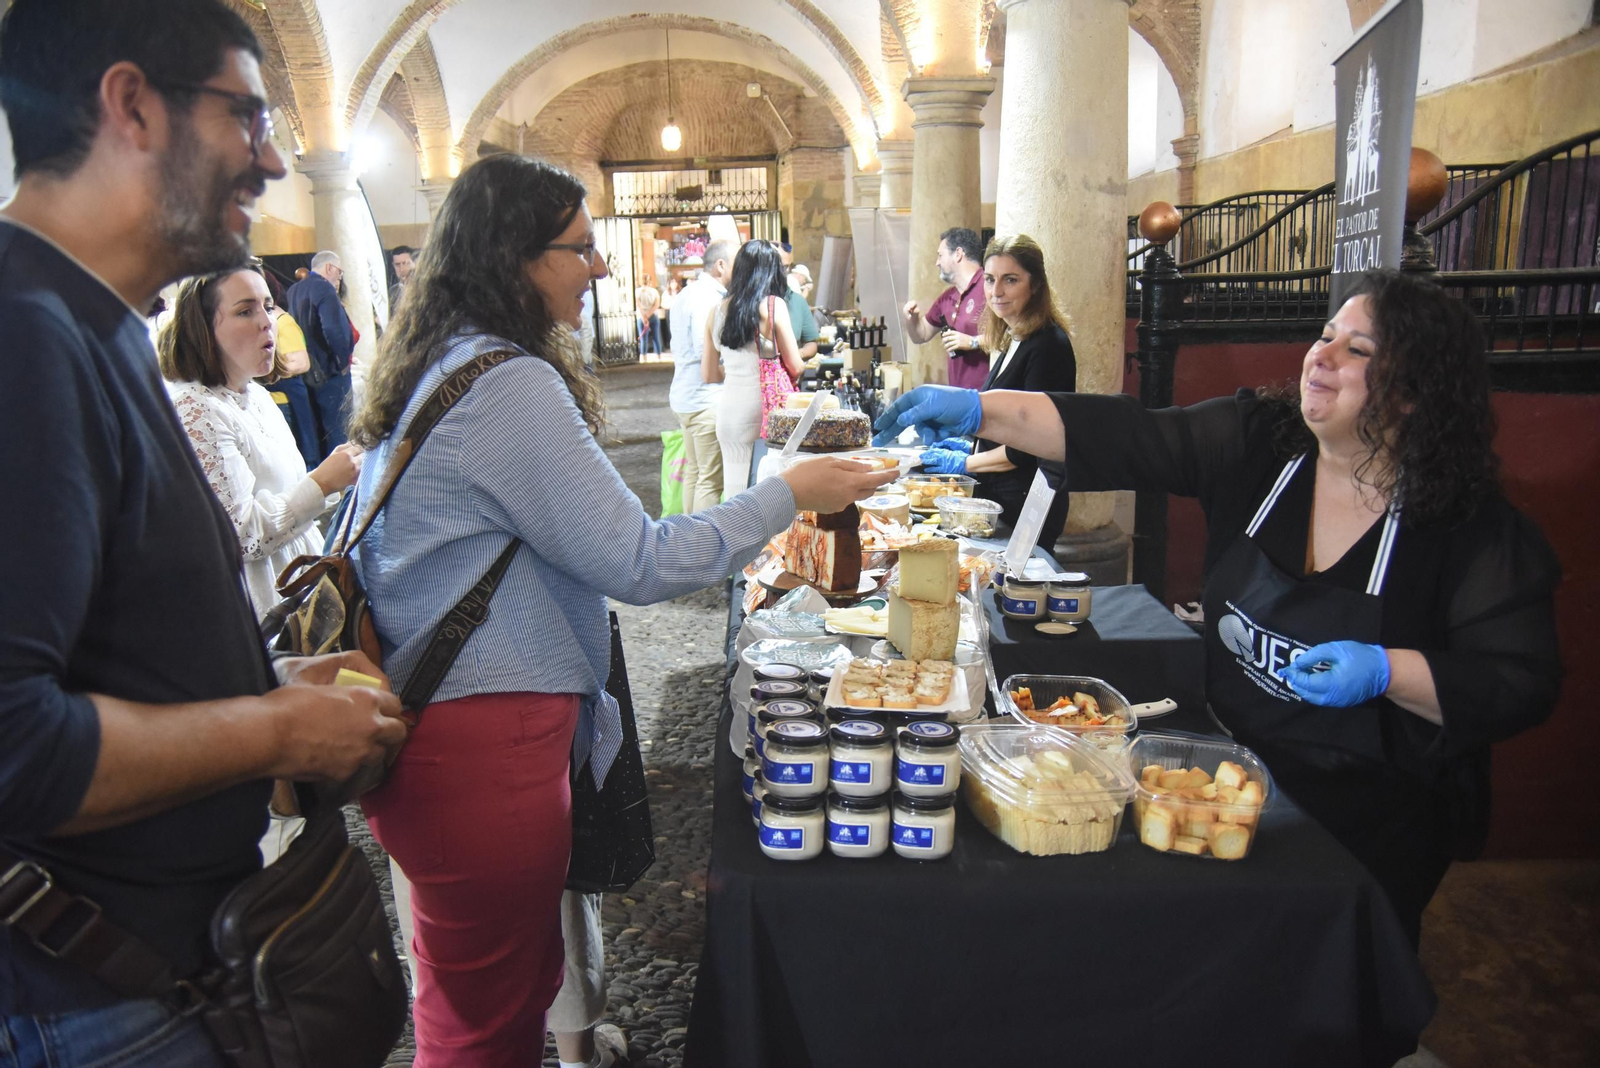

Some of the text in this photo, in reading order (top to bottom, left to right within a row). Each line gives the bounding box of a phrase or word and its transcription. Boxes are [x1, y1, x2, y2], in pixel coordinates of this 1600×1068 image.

[1336, 218, 1344, 238] EL
[1368, 207, 1379, 231] DE
[1342, 235, 1382, 273] TORCAL
[1235, 657, 1261, 677] EUROPEAN
[1260, 674, 1279, 691] CHEESE
